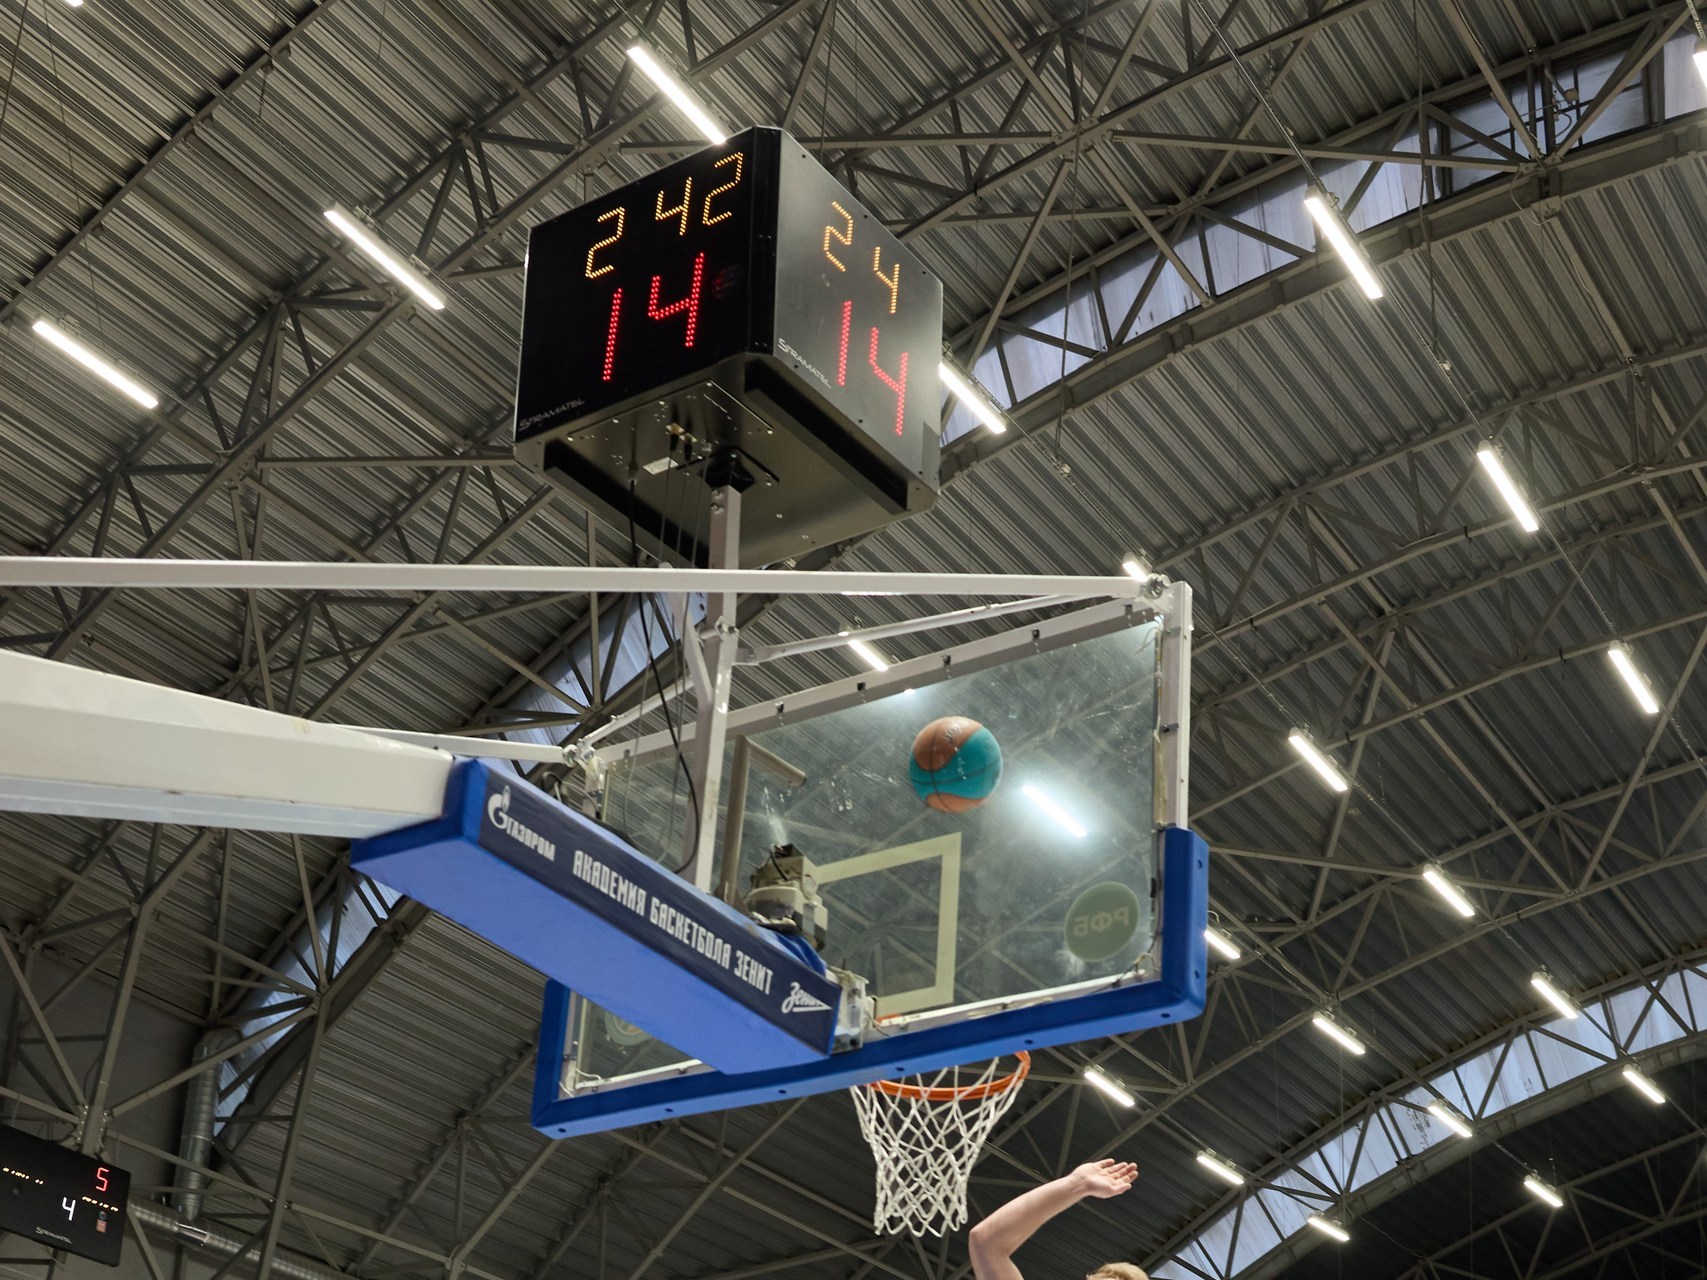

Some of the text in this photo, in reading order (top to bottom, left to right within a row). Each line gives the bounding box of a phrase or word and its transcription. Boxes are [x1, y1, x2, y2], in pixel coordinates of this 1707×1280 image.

[585, 206, 625, 279] 2
[602, 252, 705, 382] 14
[837, 300, 909, 436] 14
[572, 849, 648, 918] АКАДЕМИЯ
[650, 896, 732, 971] БАСКЕТБОЛА
[733, 950, 774, 996] ЗЕНИТ
[61, 1196, 77, 1222] 4
[95, 1166, 110, 1192] 5
